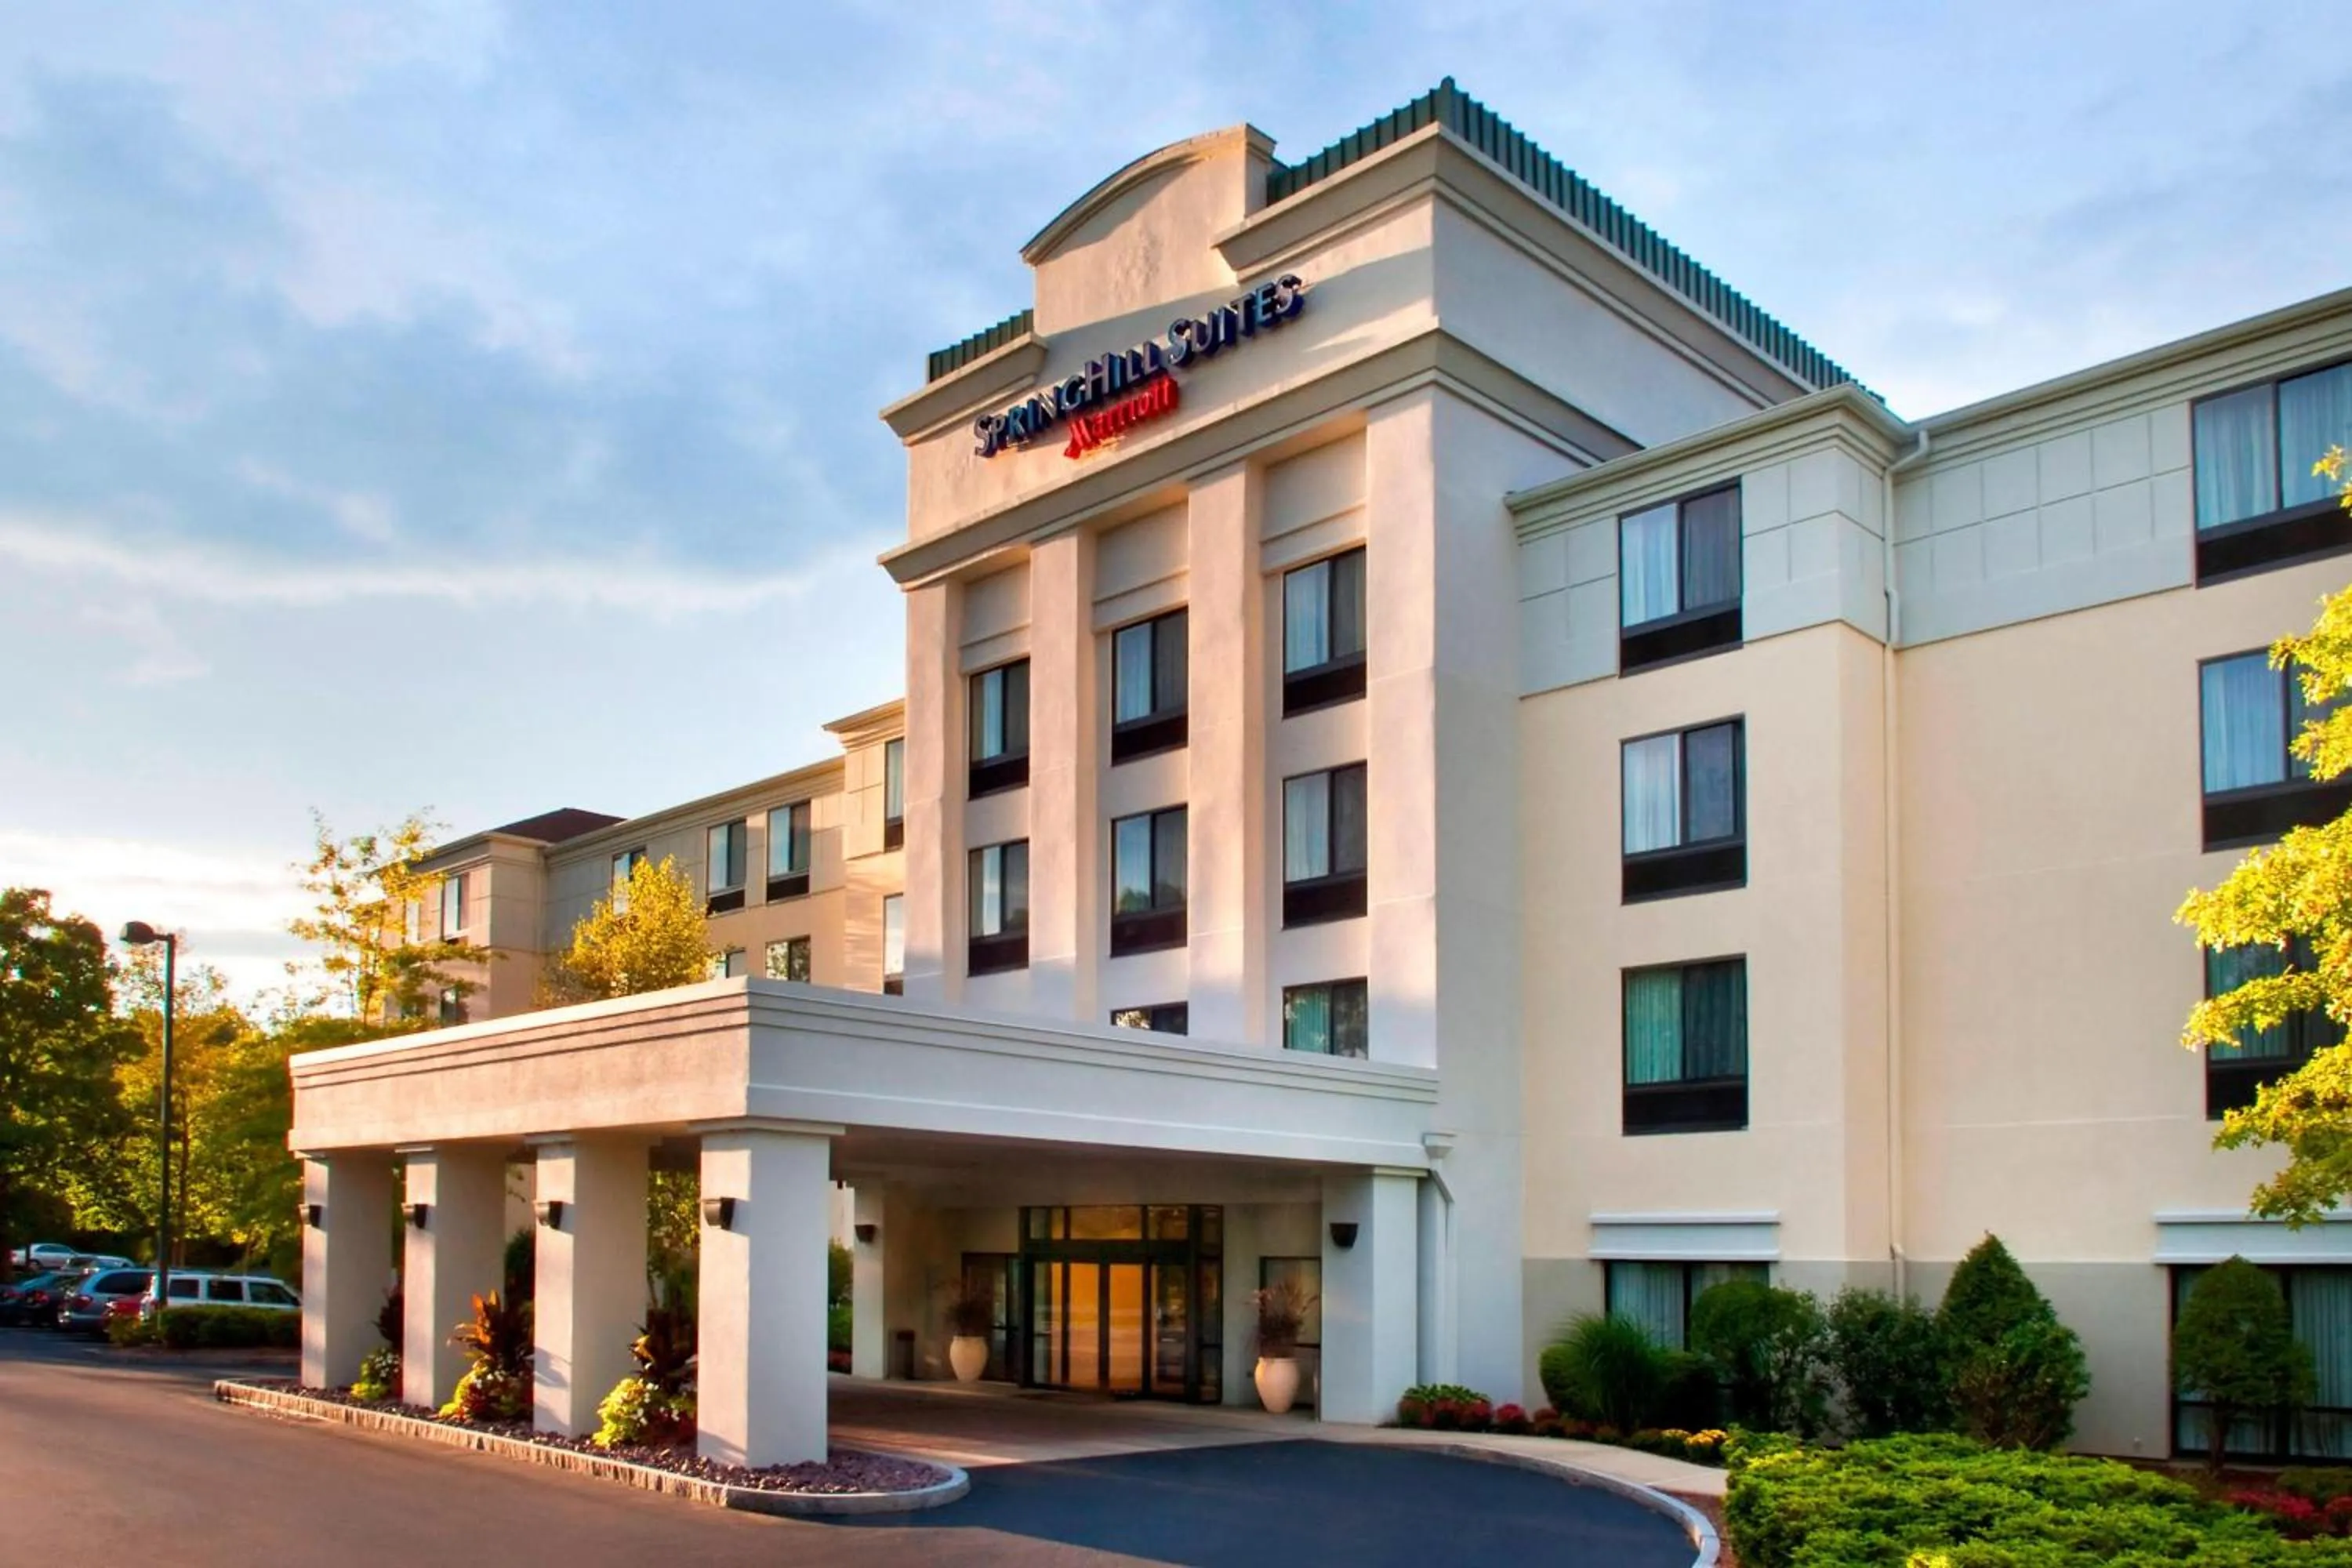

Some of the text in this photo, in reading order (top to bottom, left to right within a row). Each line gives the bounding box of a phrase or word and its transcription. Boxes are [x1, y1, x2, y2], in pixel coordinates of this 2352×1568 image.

[974, 274, 1305, 458] SPRINGHILL SUITES
[1064, 374, 1180, 459] Marriott
